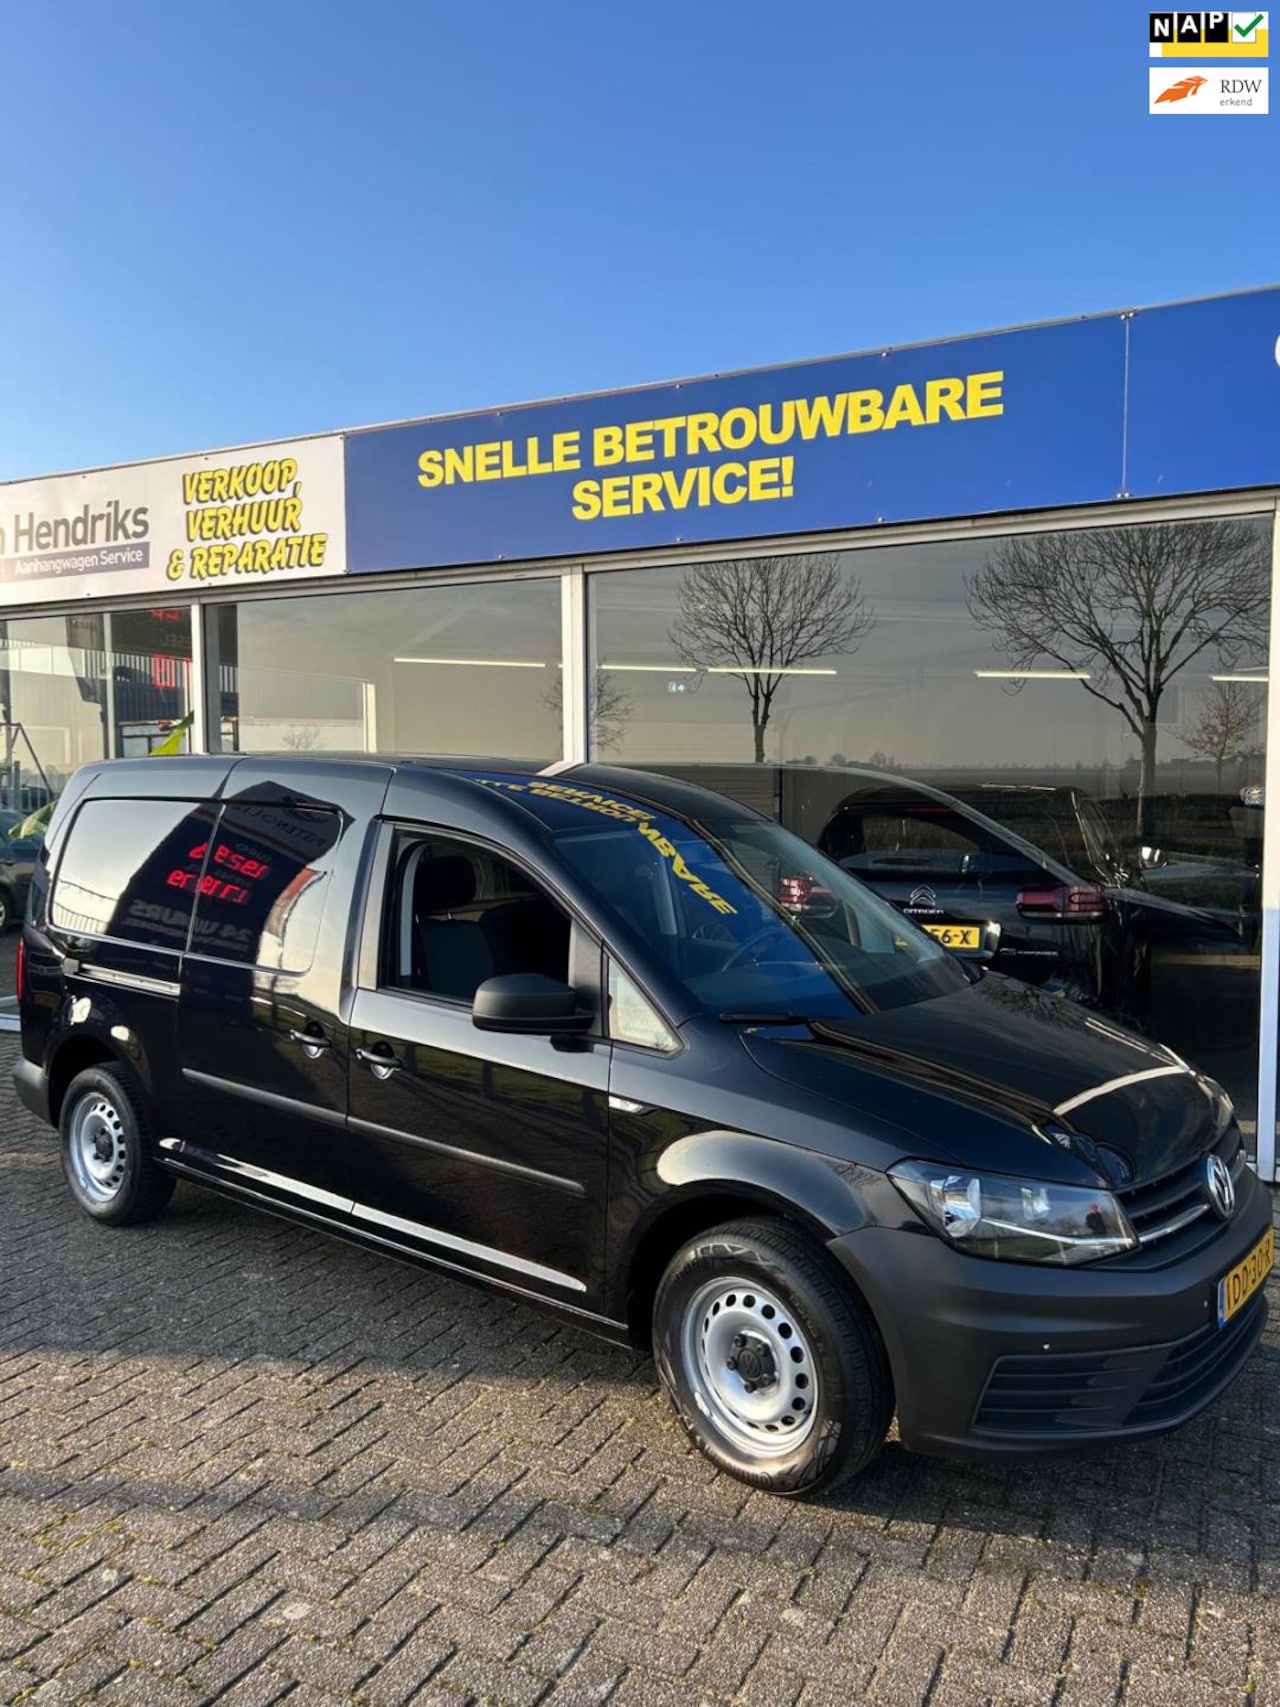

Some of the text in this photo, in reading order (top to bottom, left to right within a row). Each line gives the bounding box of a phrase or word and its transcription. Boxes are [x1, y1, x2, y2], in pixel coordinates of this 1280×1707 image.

[417, 370, 1004, 488] SNELLE BETROUWBARE
[183, 457, 303, 505] VERKOOP,
[571, 456, 794, 521] SERVICE!
[14, 499, 149, 553] Hendriks
[186, 497, 303, 541] VERHUUR
[15, 547, 143, 575] Aanhangwagen Service
[166, 533, 328, 581] & REPARATIE
[931, 927, 972, 945] 6-X
